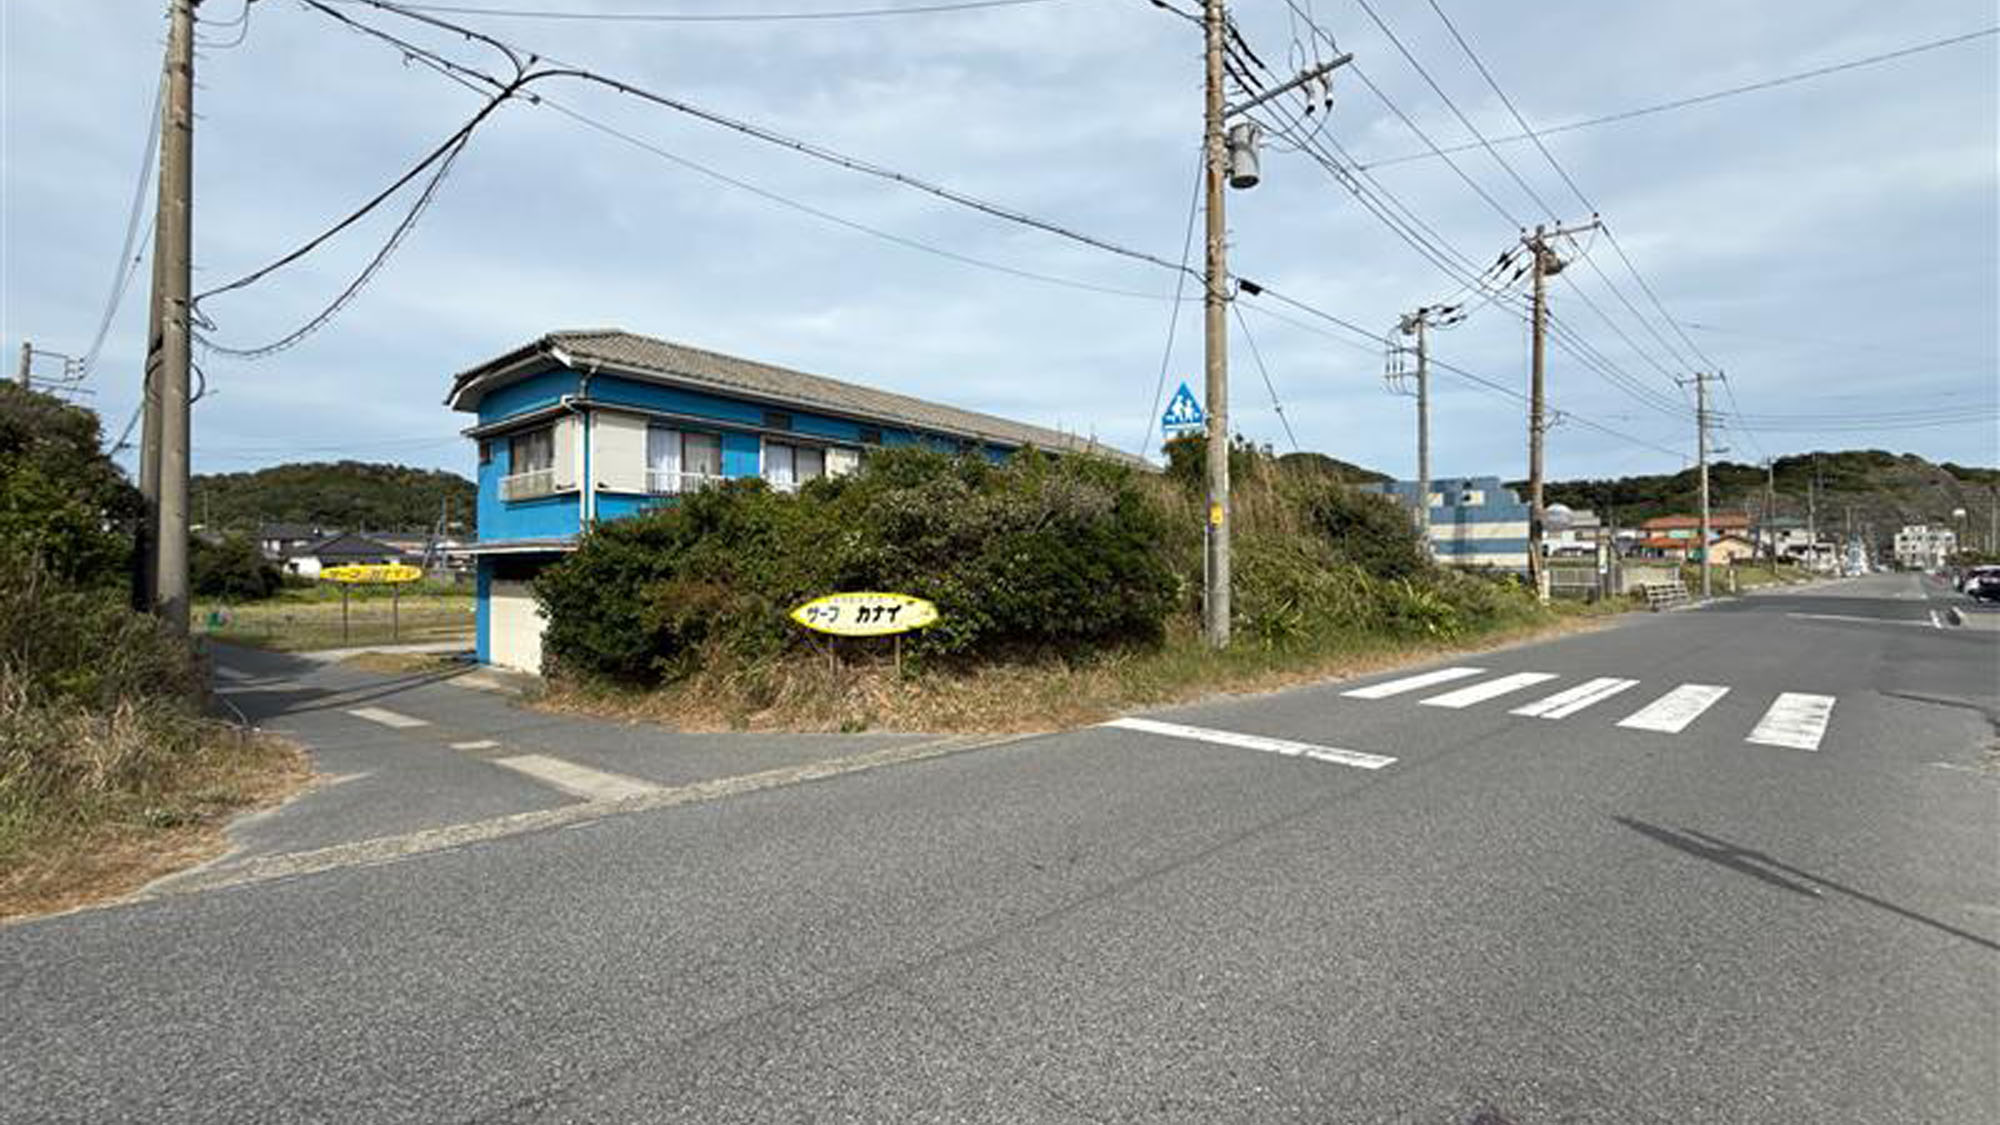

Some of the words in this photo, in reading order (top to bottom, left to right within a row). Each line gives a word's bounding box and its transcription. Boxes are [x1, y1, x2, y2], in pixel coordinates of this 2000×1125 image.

[807, 606, 840, 623] サーフ
[856, 605, 902, 623] カナイ
